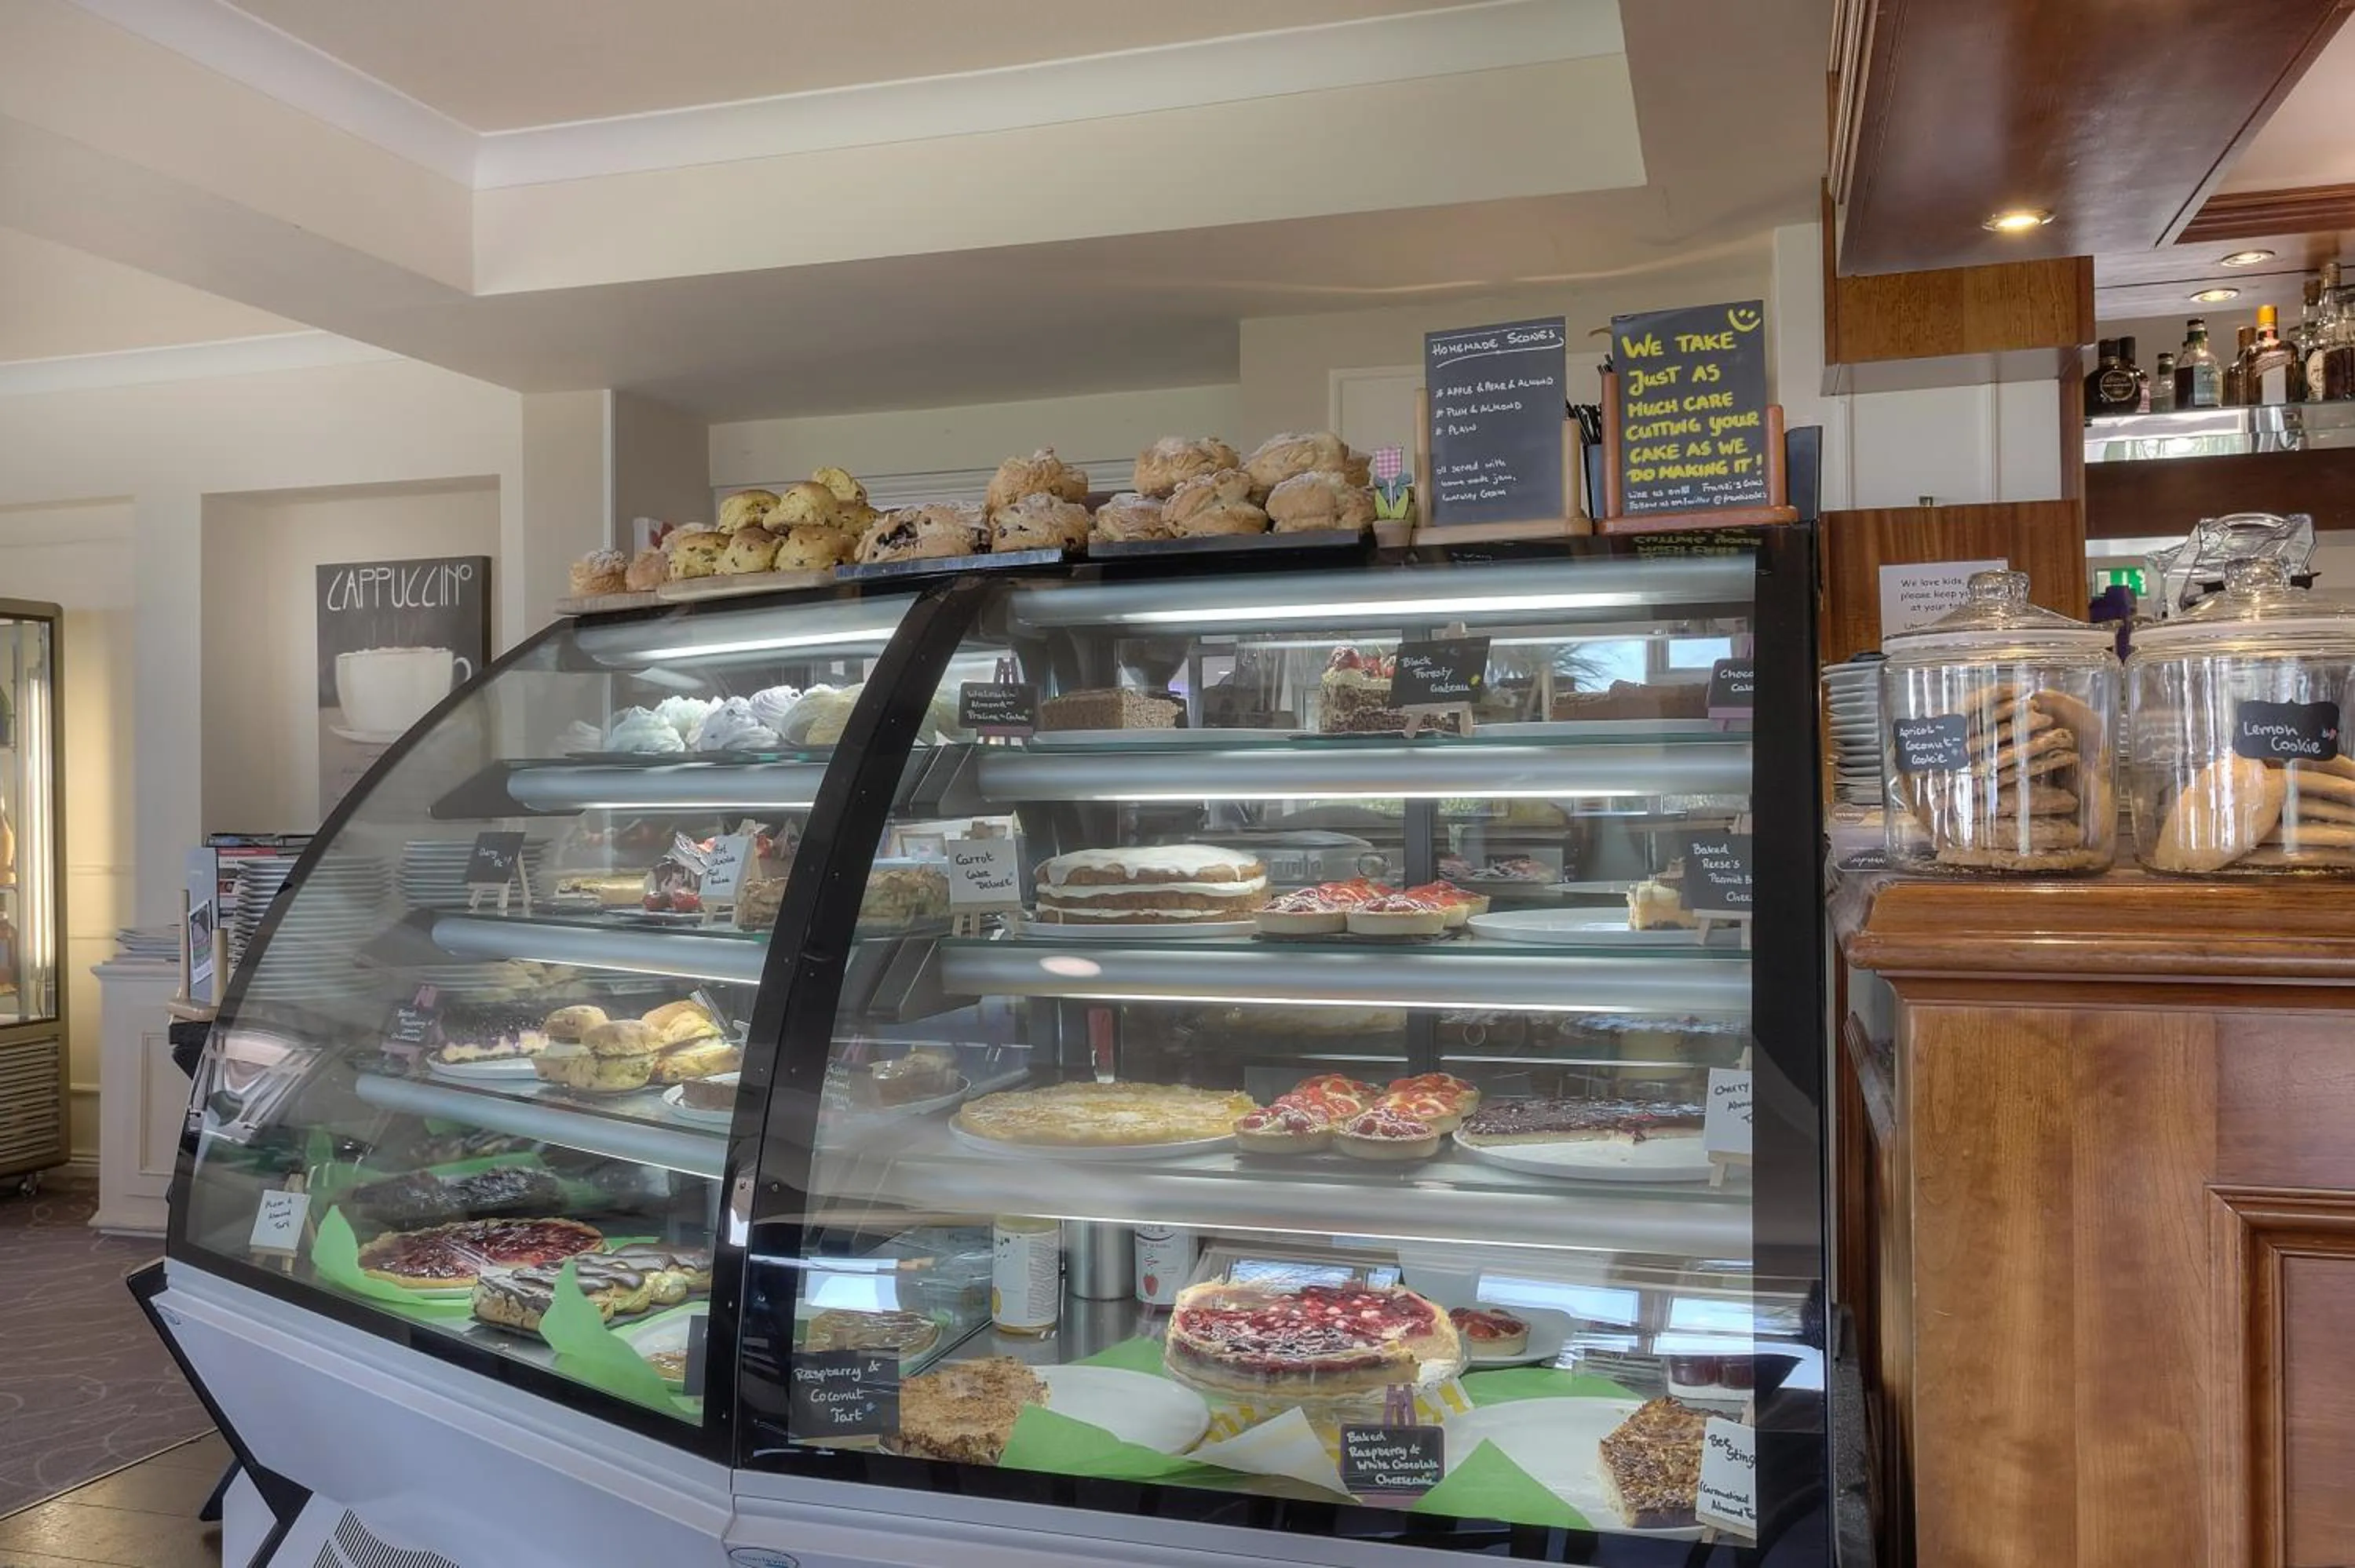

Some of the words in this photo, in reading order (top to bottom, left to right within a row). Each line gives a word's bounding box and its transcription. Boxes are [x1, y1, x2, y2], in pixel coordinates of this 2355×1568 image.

[1507, 330, 1556, 345] SCONES
[1621, 332, 1664, 359] WE
[1674, 331, 1737, 352] TAKE
[1628, 365, 1682, 396] JUST
[1692, 363, 1722, 384] AS
[1627, 398, 1678, 418] MUCH
[1683, 392, 1734, 411] CARE
[1625, 418, 1702, 442] CUTTING
[1629, 443, 1681, 465] CAKE
[1686, 440, 1712, 457] AS
[1718, 437, 1749, 454] WE
[1659, 460, 1728, 480] MAKING
[327, 563, 473, 611] CAPPUCCINO
[1900, 578, 1916, 587] We
[1900, 591, 1932, 602] please
[1933, 589, 1957, 600] keep
[1400, 656, 1433, 667] Black
[2244, 721, 2298, 736] Lemon
[2271, 736, 2321, 754] Cookie
[1692, 843, 1729, 855] Baked
[955, 851, 994, 866] Carrot
[1701, 858, 1740, 869] Reese's
[794, 1367, 861, 1382] Raspberry
[868, 1359, 882, 1373] &
[810, 1387, 864, 1402] Coconut
[831, 1408, 864, 1423] Tart
[1346, 1431, 1386, 1443] Baked
[1708, 1434, 1732, 1449] Bee
[1349, 1446, 1407, 1460] Raspberry
[1726, 1448, 1756, 1470] Sting
[1356, 1460, 1390, 1470] White
